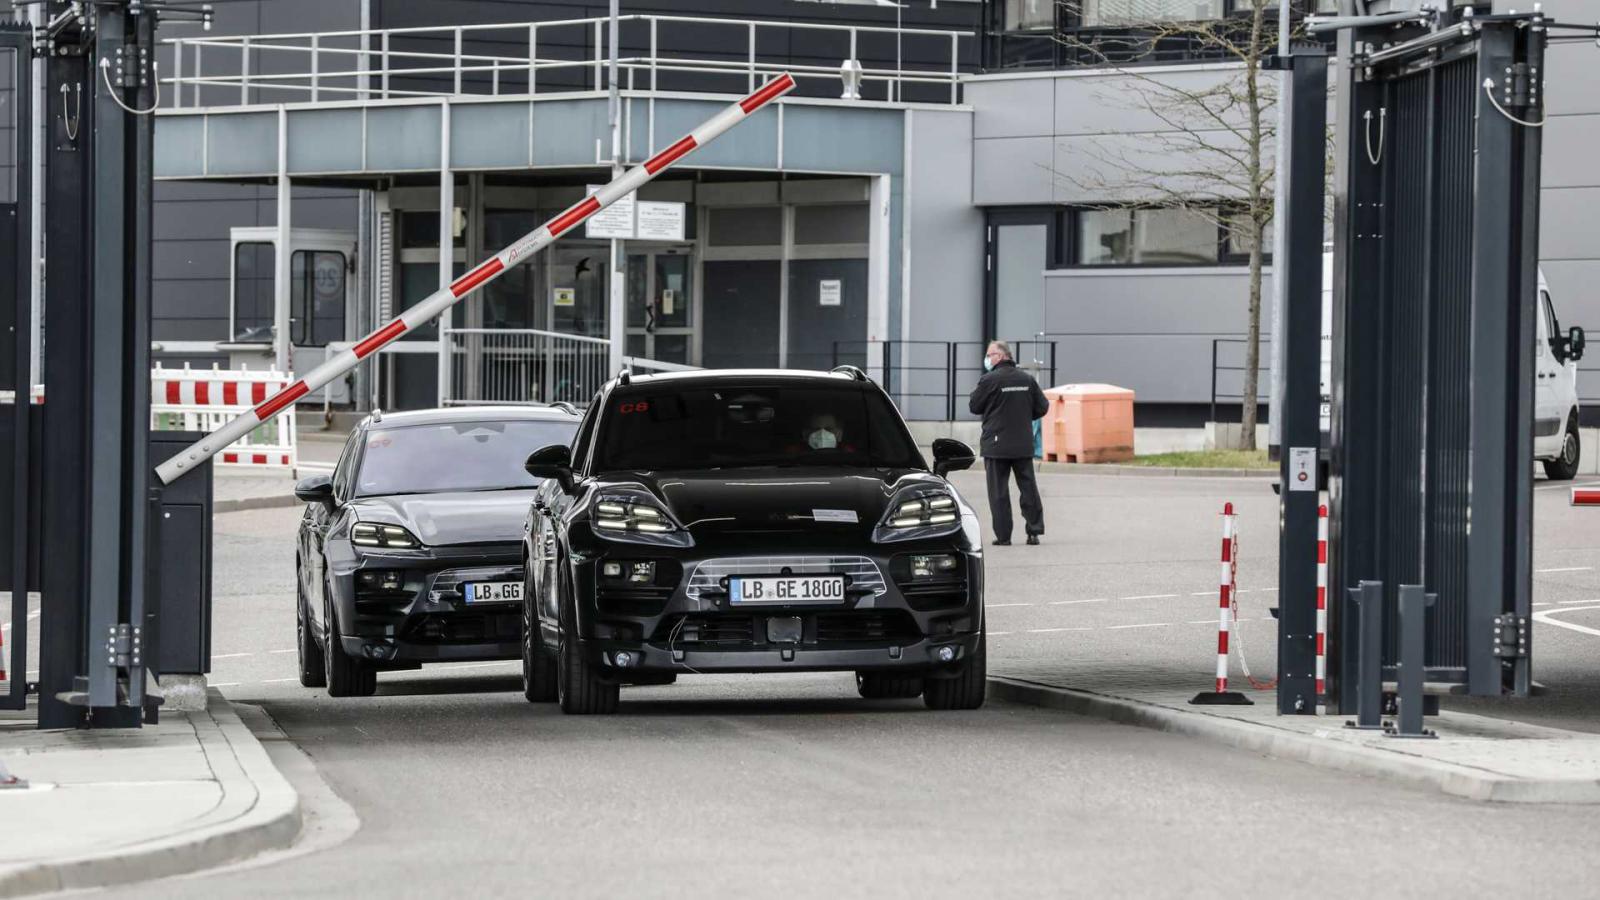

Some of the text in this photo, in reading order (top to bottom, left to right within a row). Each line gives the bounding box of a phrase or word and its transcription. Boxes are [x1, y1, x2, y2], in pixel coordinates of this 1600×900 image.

[474, 584, 520, 600] LB GG
[742, 579, 842, 599] LB GE 1800
